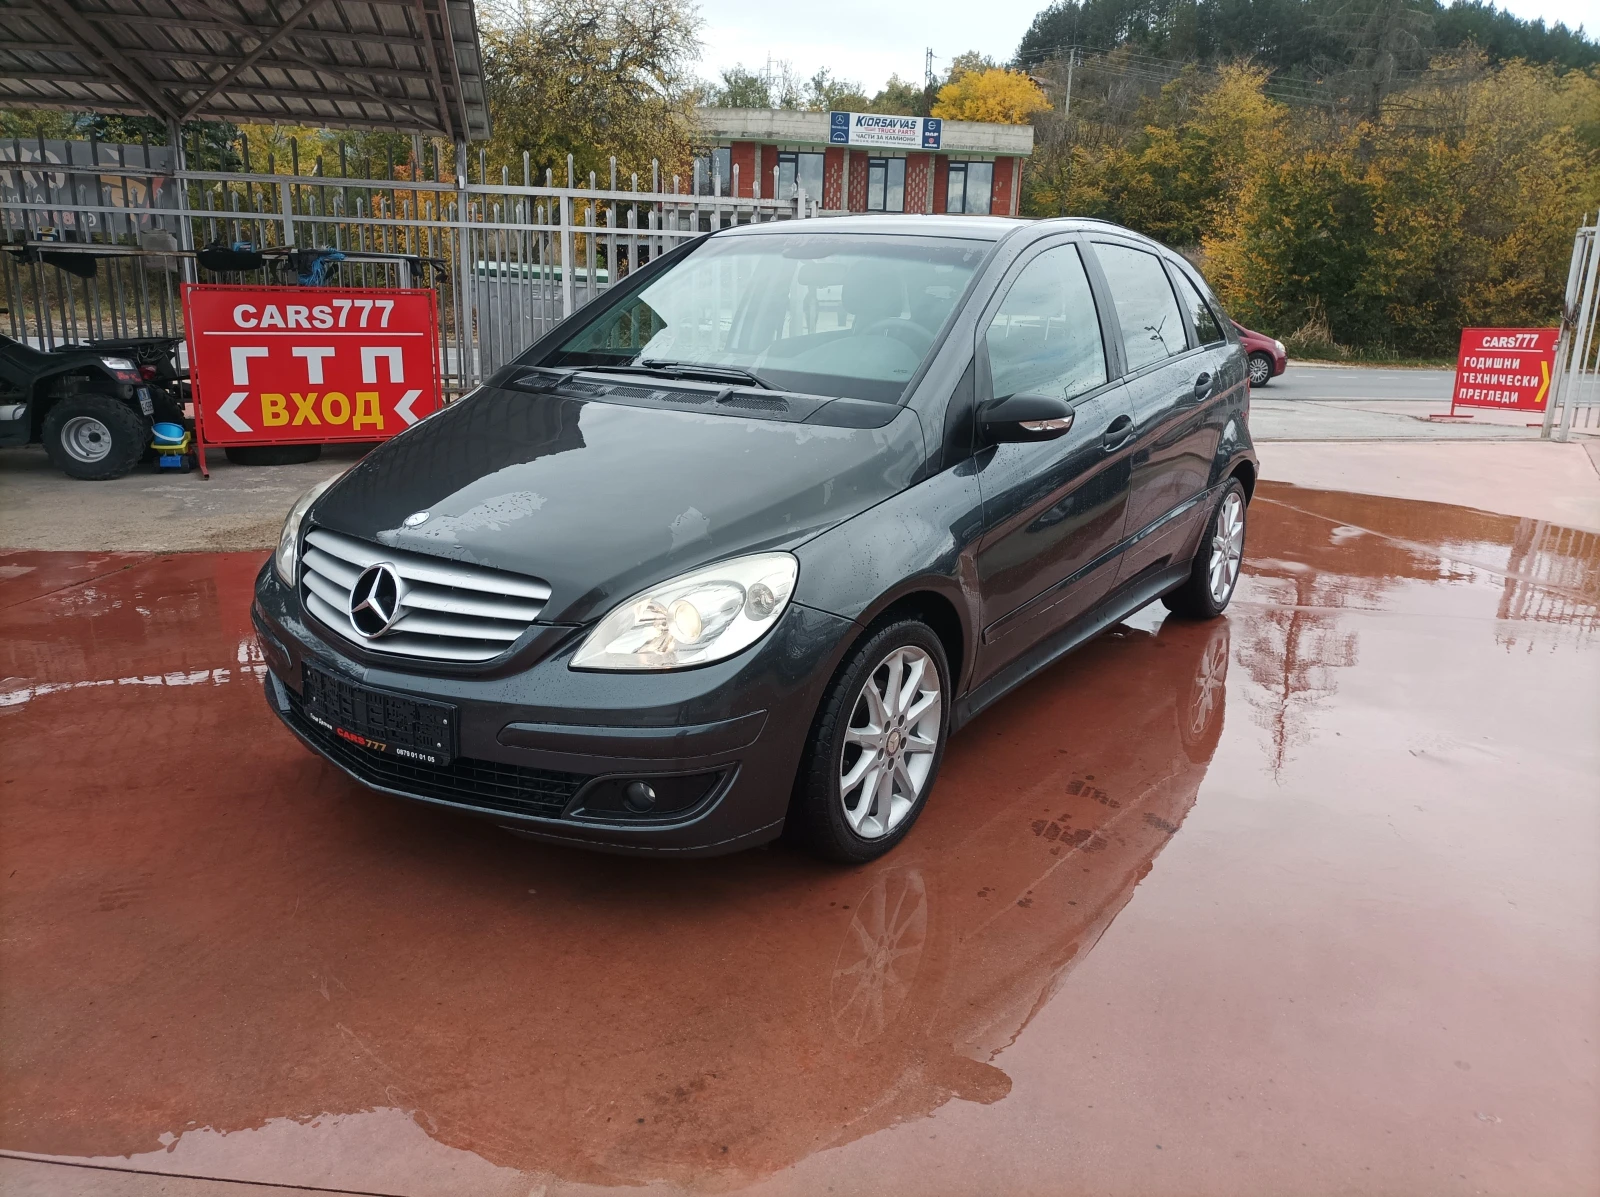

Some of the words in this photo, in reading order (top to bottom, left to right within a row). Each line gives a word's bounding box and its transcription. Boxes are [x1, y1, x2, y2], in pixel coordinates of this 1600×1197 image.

[856, 115, 917, 129] KIORSAVVAS
[233, 299, 394, 329] CARS777
[1482, 334, 1539, 348] CARS777
[1463, 357, 1521, 370] ГОДИШНИ
[1462, 373, 1539, 387] ТЕХНИЧЕСКИ
[1459, 388, 1519, 404] ПРЕГЛЕДИ
[260, 391, 384, 431] ВХОД
